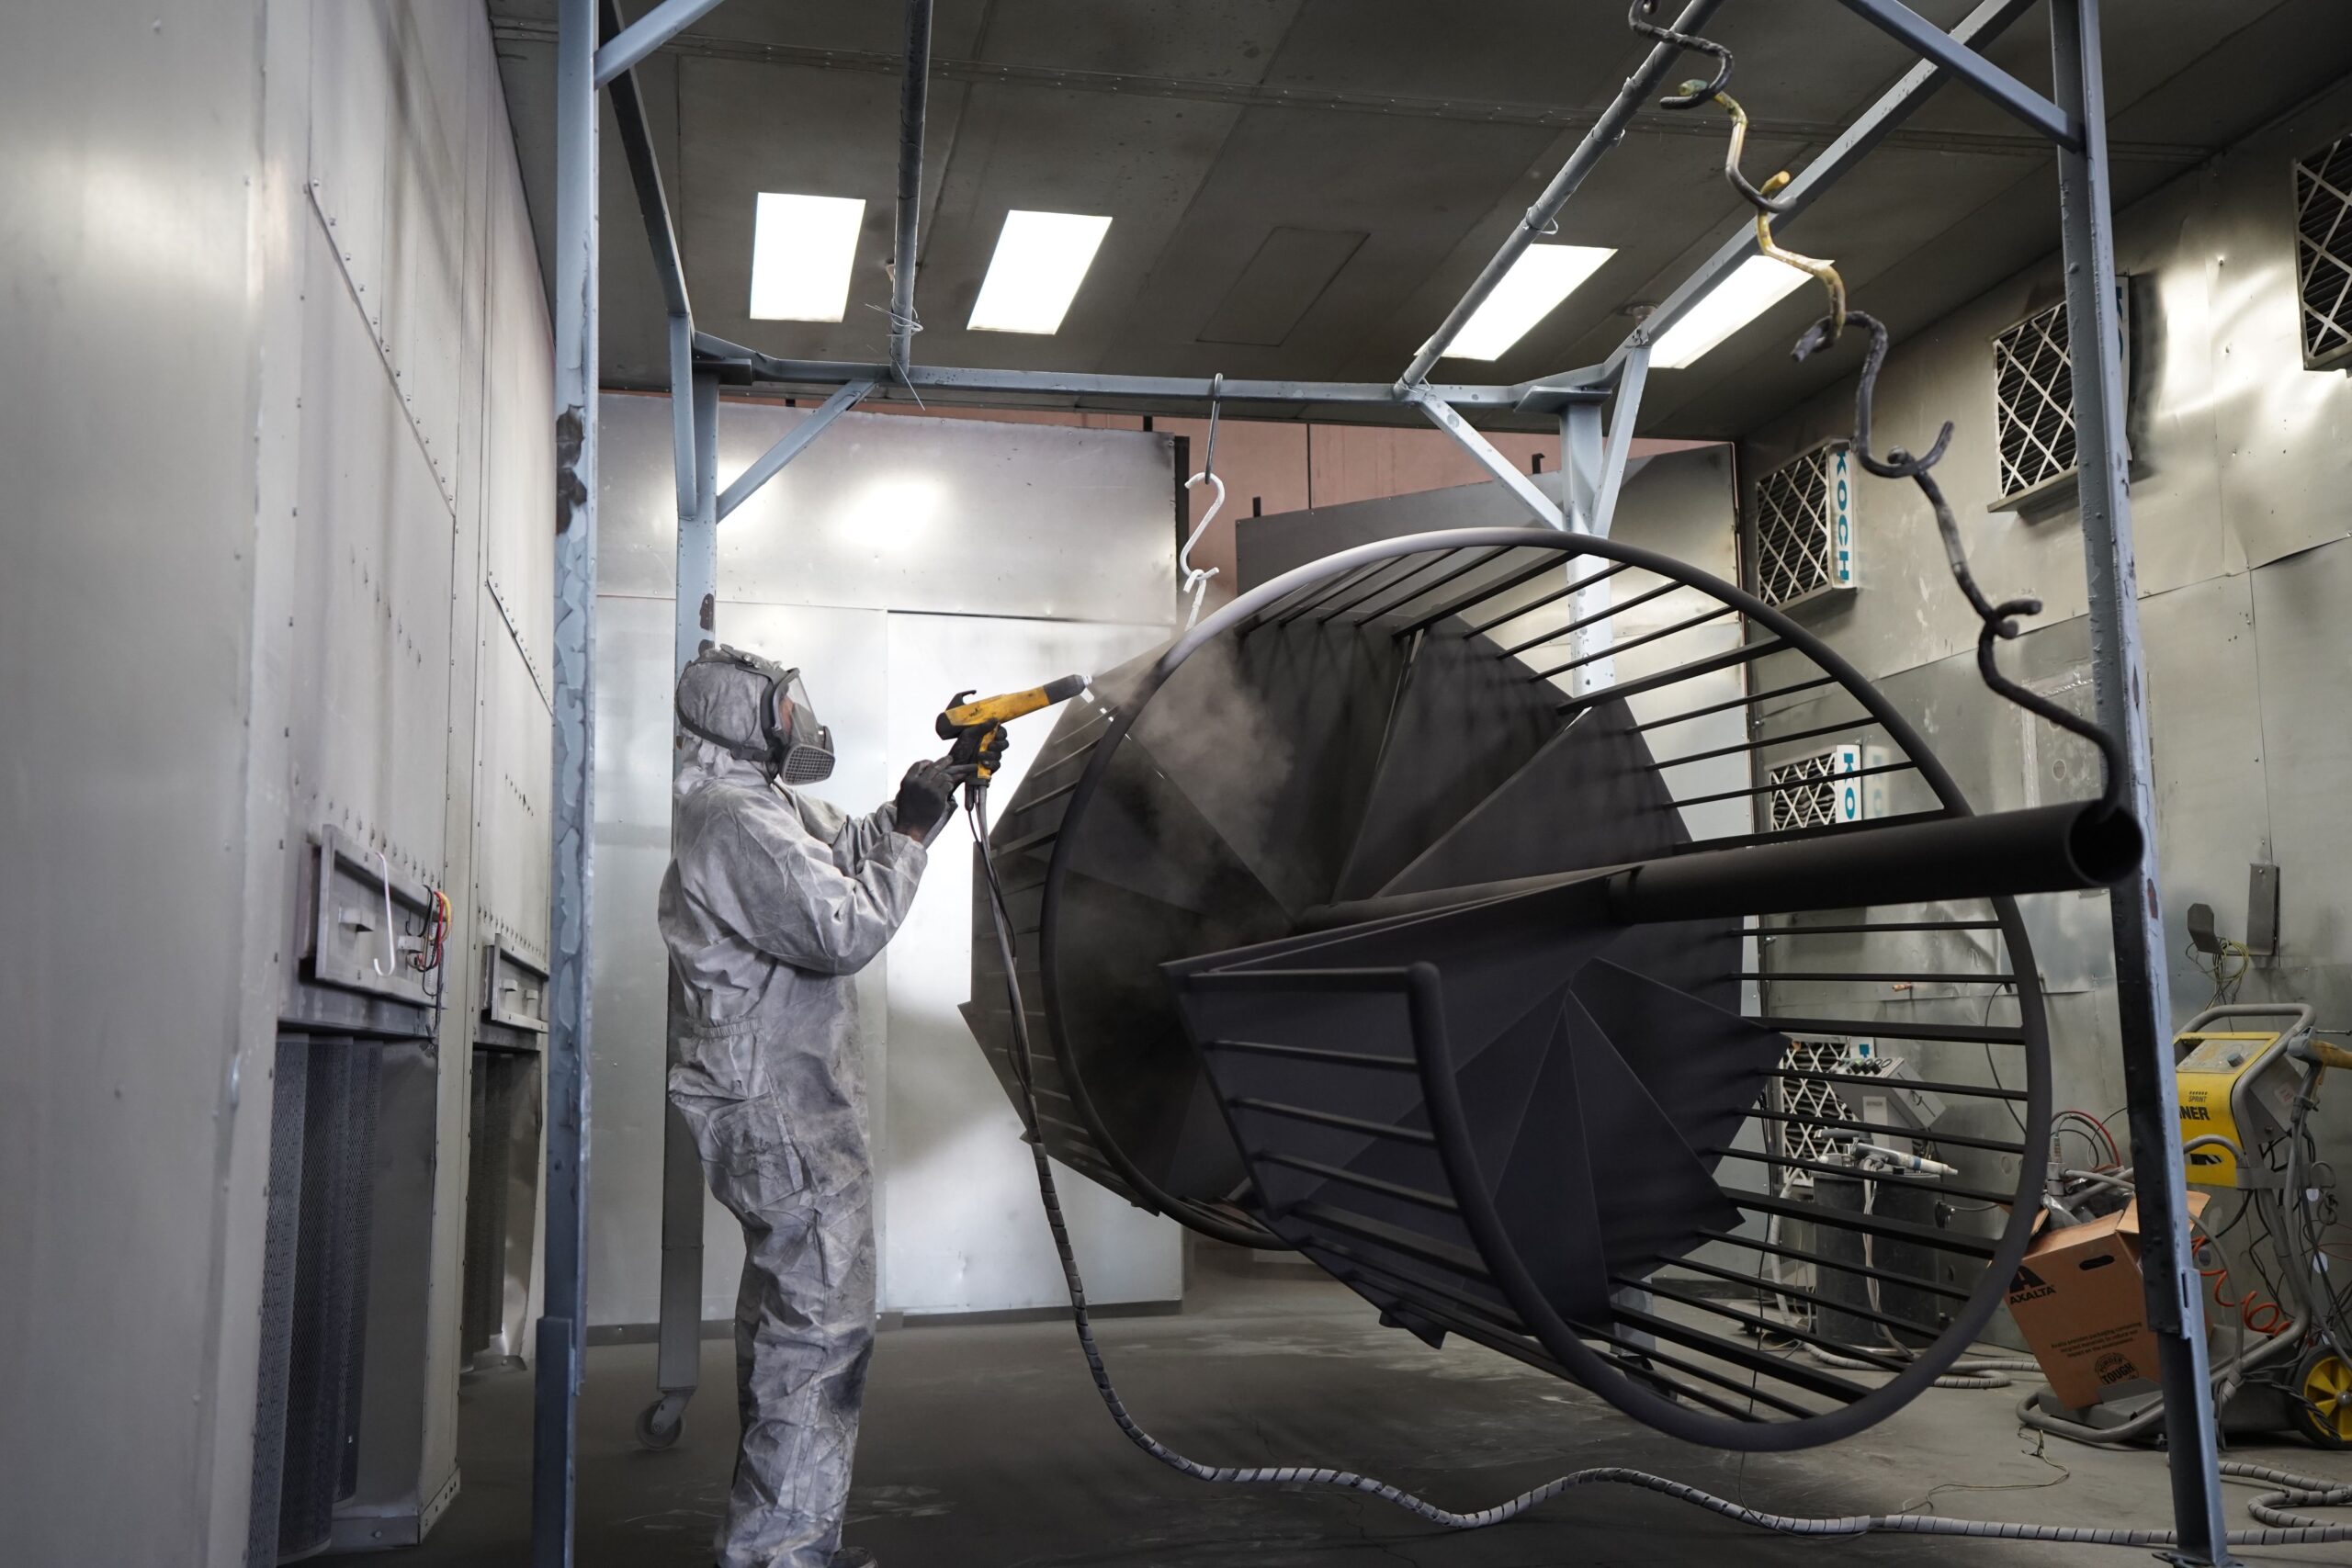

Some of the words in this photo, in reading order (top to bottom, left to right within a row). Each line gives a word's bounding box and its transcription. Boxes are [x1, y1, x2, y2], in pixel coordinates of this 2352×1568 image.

[1838, 450, 1849, 581] KOCH
[1843, 752, 1856, 820] KO
[2179, 1105, 2211, 1121] NER
[2010, 1286, 2057, 1304] AXALTA
[2101, 1362, 2135, 1384] TOUGH
